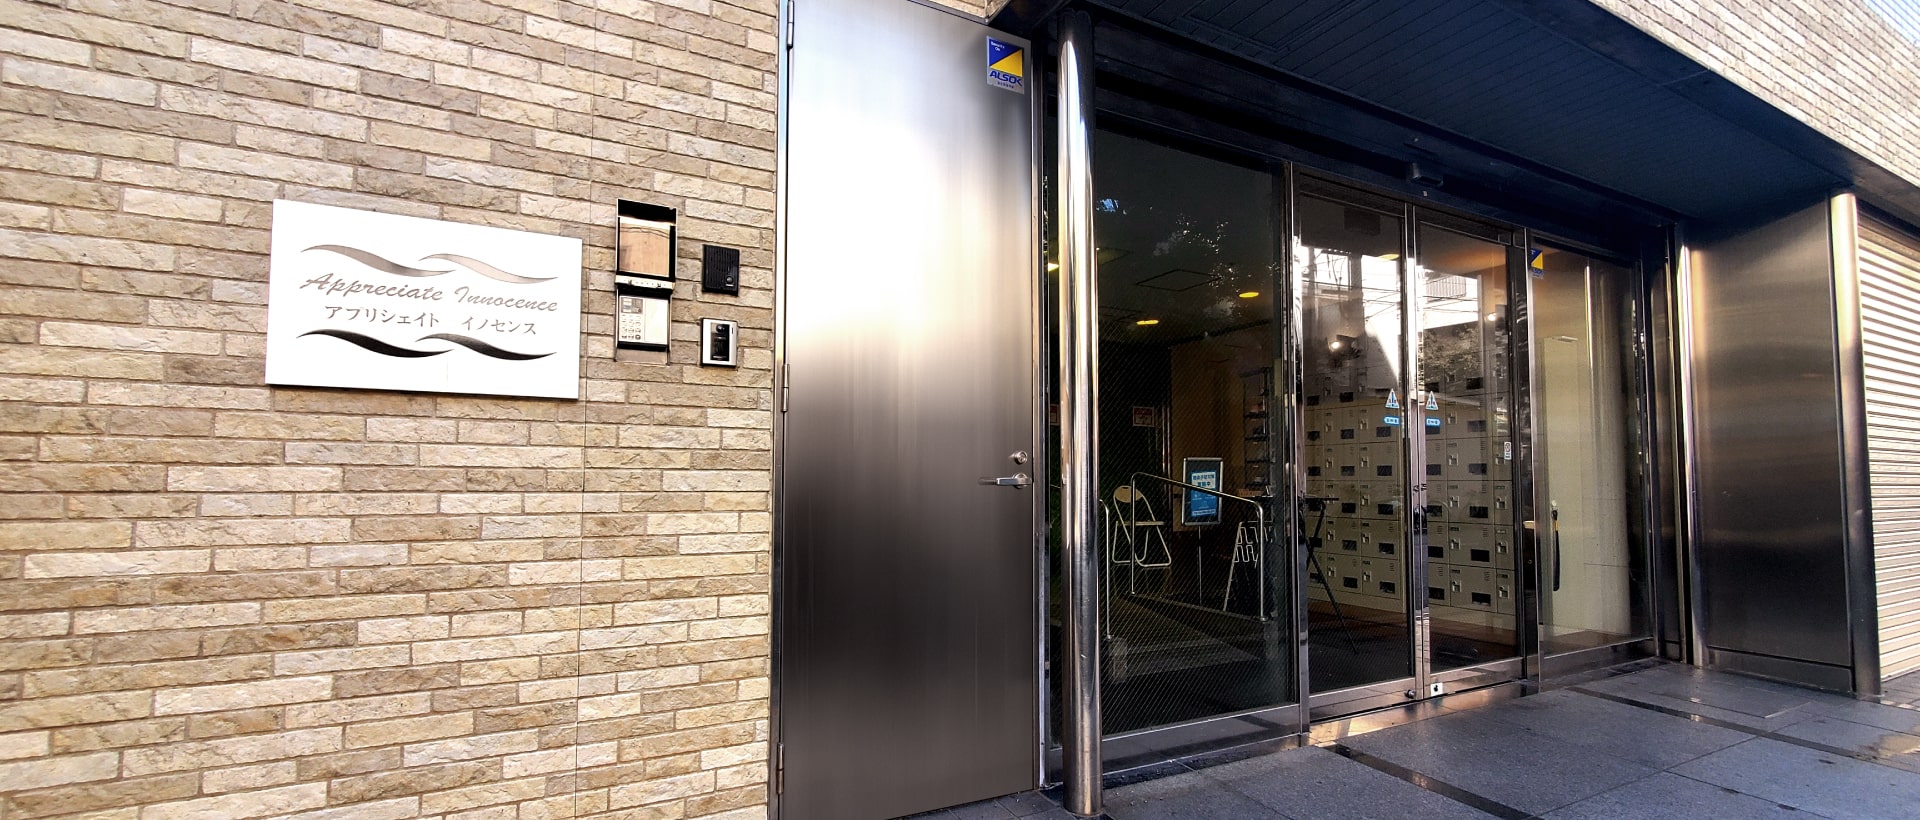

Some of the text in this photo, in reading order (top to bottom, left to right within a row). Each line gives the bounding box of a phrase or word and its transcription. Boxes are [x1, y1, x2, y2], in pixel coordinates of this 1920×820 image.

[990, 71, 1022, 87] ALSOK
[300, 273, 558, 311] Appreciate Innocence
[325, 305, 537, 335] アプリシェイト イノセンス
